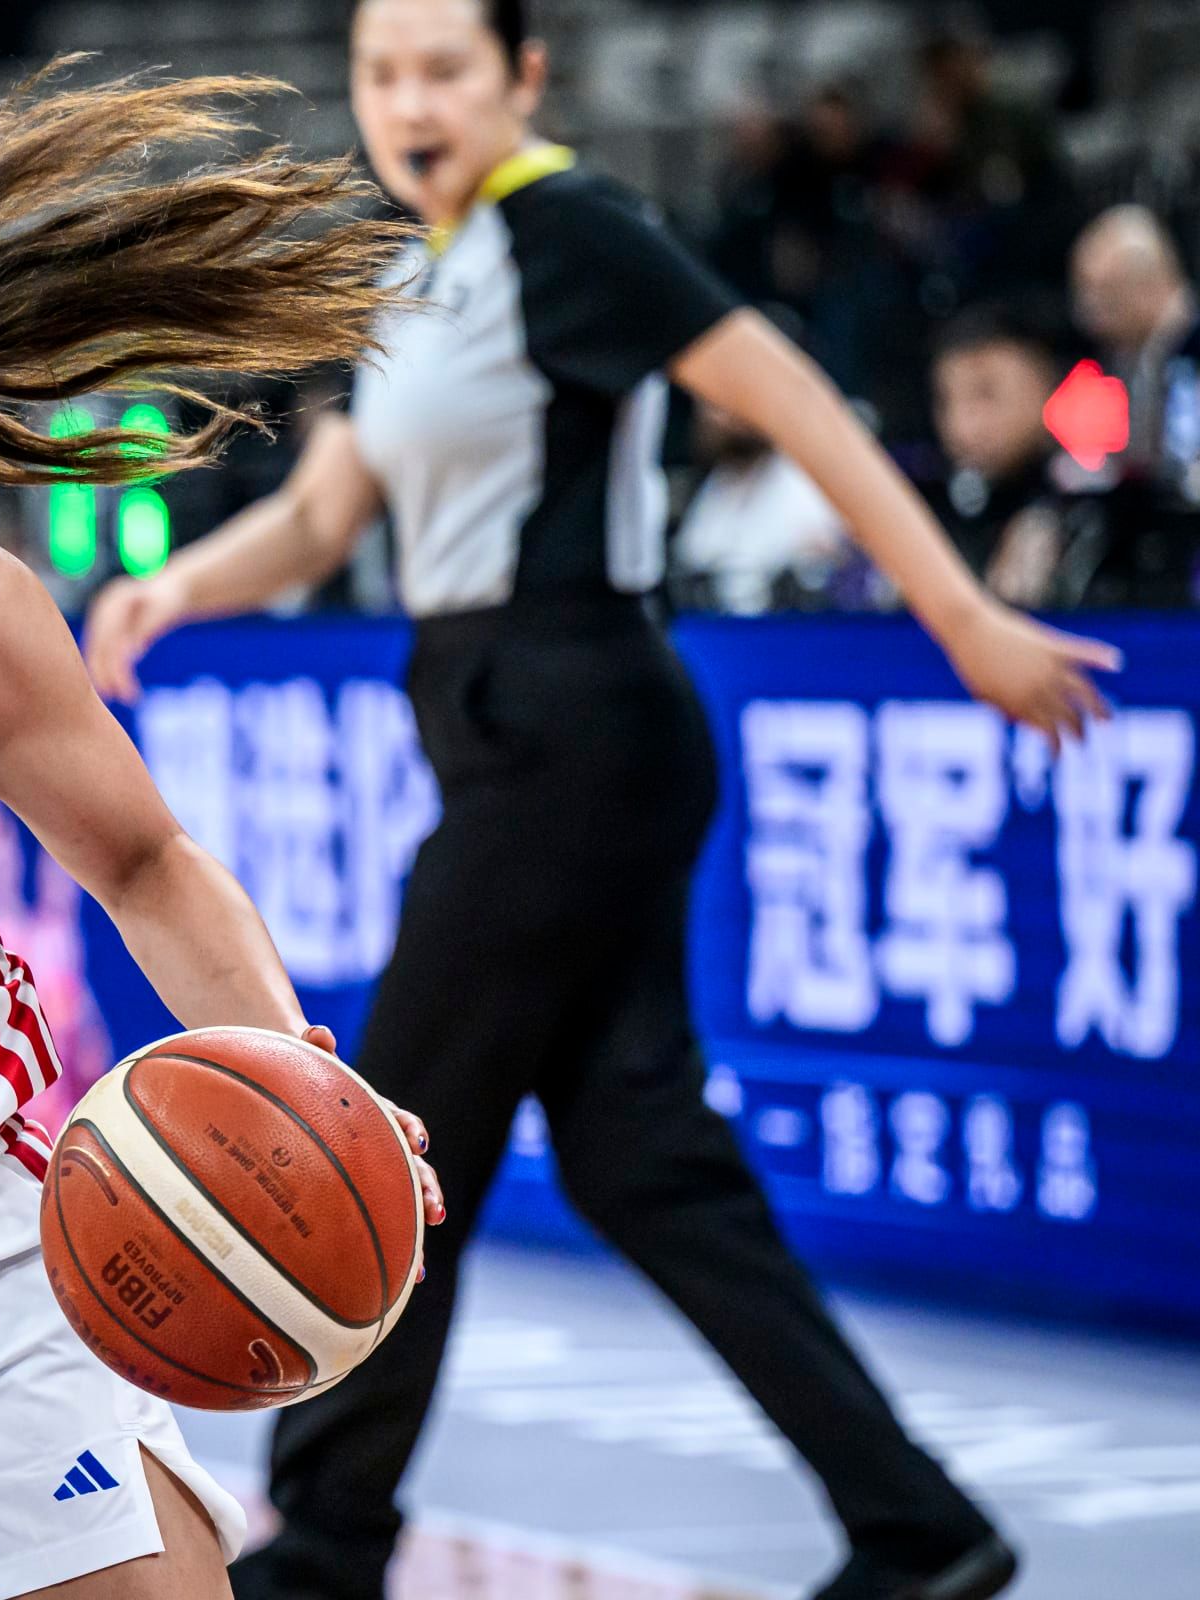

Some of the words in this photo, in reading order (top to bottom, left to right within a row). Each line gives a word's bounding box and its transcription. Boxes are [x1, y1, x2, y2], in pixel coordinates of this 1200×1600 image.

[204, 1122, 229, 1147] BALL
[226, 1143, 256, 1172] GAME
[101, 1252, 173, 1330] FIBA
[123, 1239, 186, 1305] APPROVED
